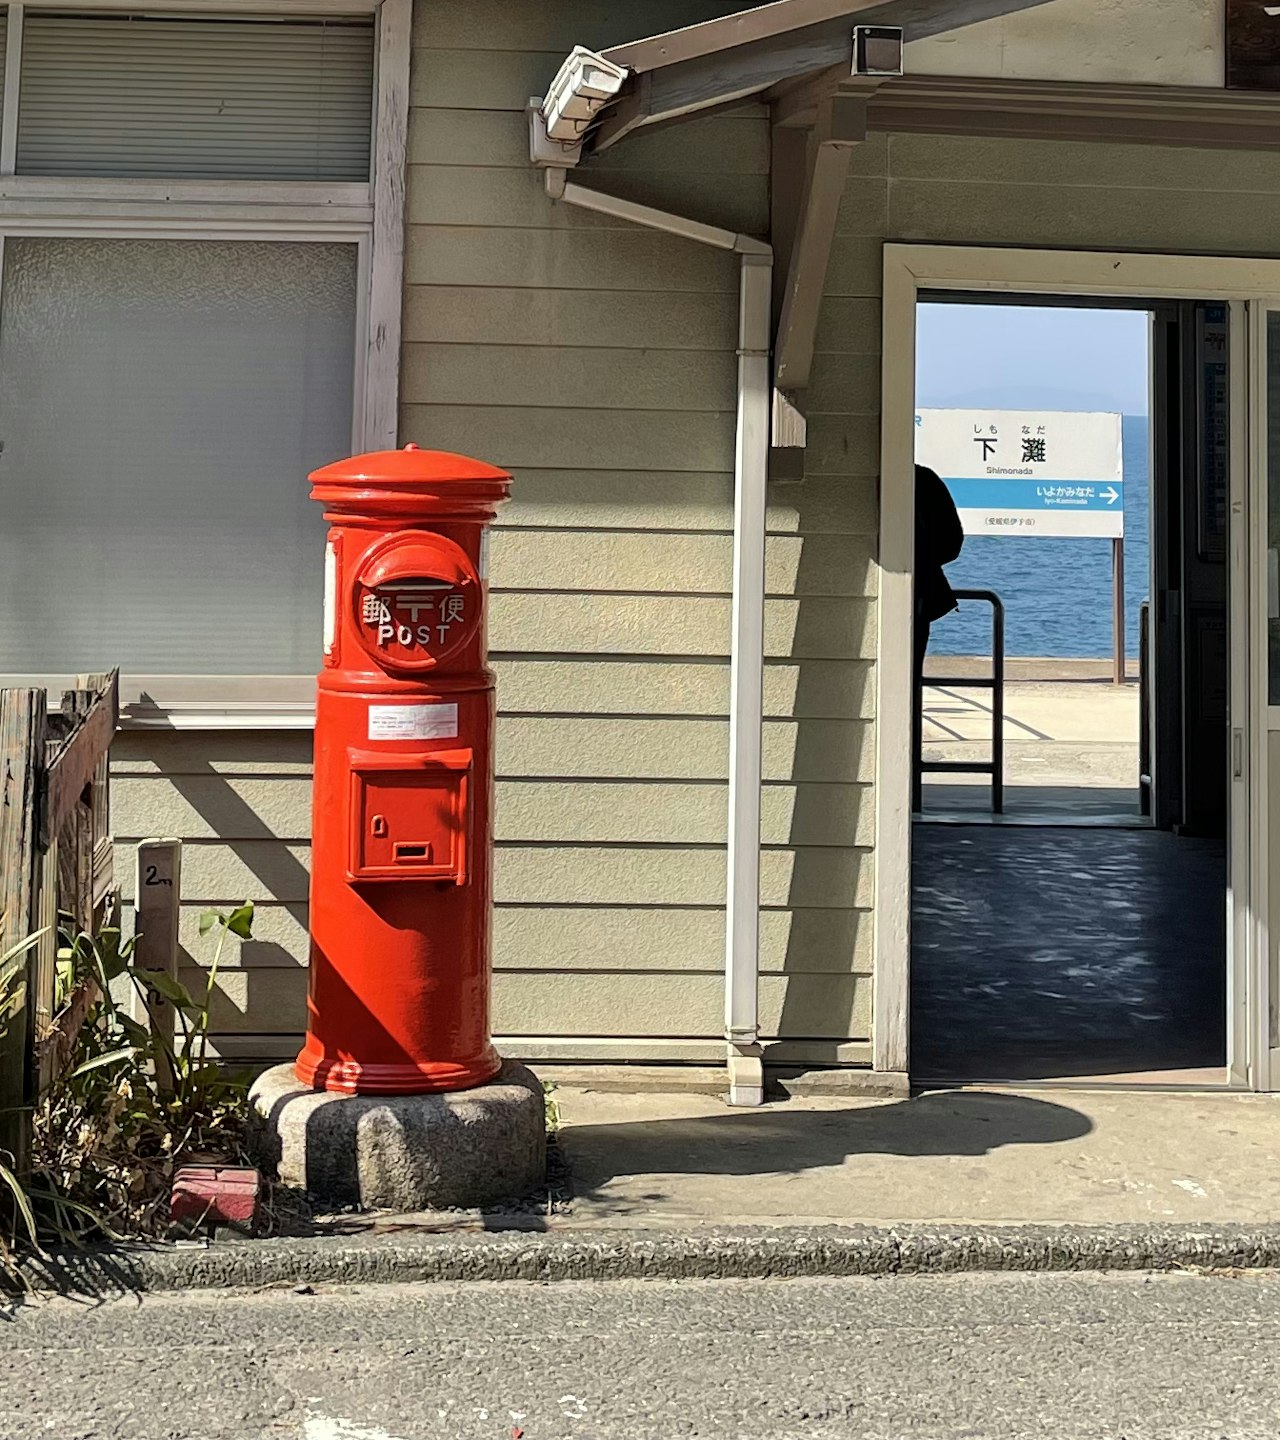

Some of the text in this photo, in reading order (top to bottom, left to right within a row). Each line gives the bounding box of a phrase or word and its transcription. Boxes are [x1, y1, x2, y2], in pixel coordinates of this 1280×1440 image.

[985, 466, 1034, 475] Shimonada
[1035, 485, 1096, 498] いよかみなだ
[376, 624, 451, 646] POST
